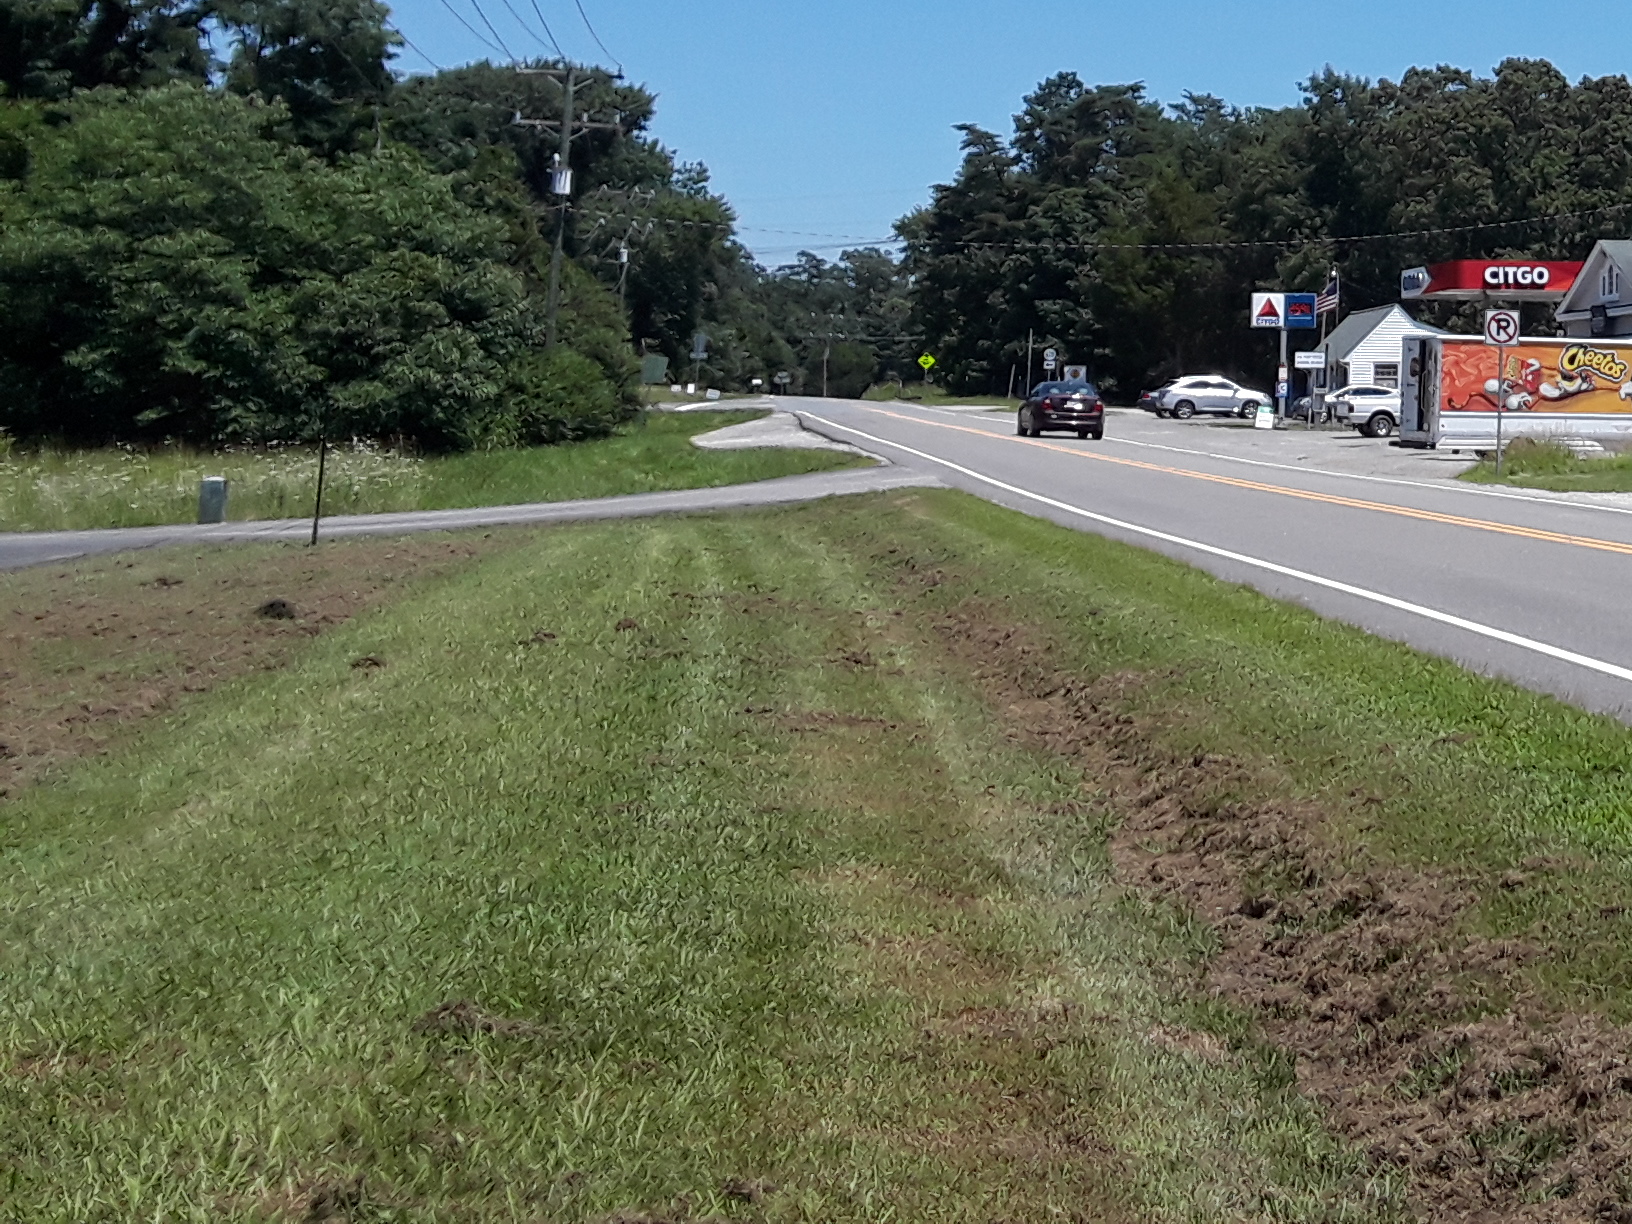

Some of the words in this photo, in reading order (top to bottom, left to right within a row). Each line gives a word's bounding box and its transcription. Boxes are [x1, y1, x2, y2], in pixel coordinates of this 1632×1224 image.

[1484, 266, 1550, 285] CITGO
[1497, 317, 1511, 336] P
[1562, 345, 1627, 380] Cheetos
